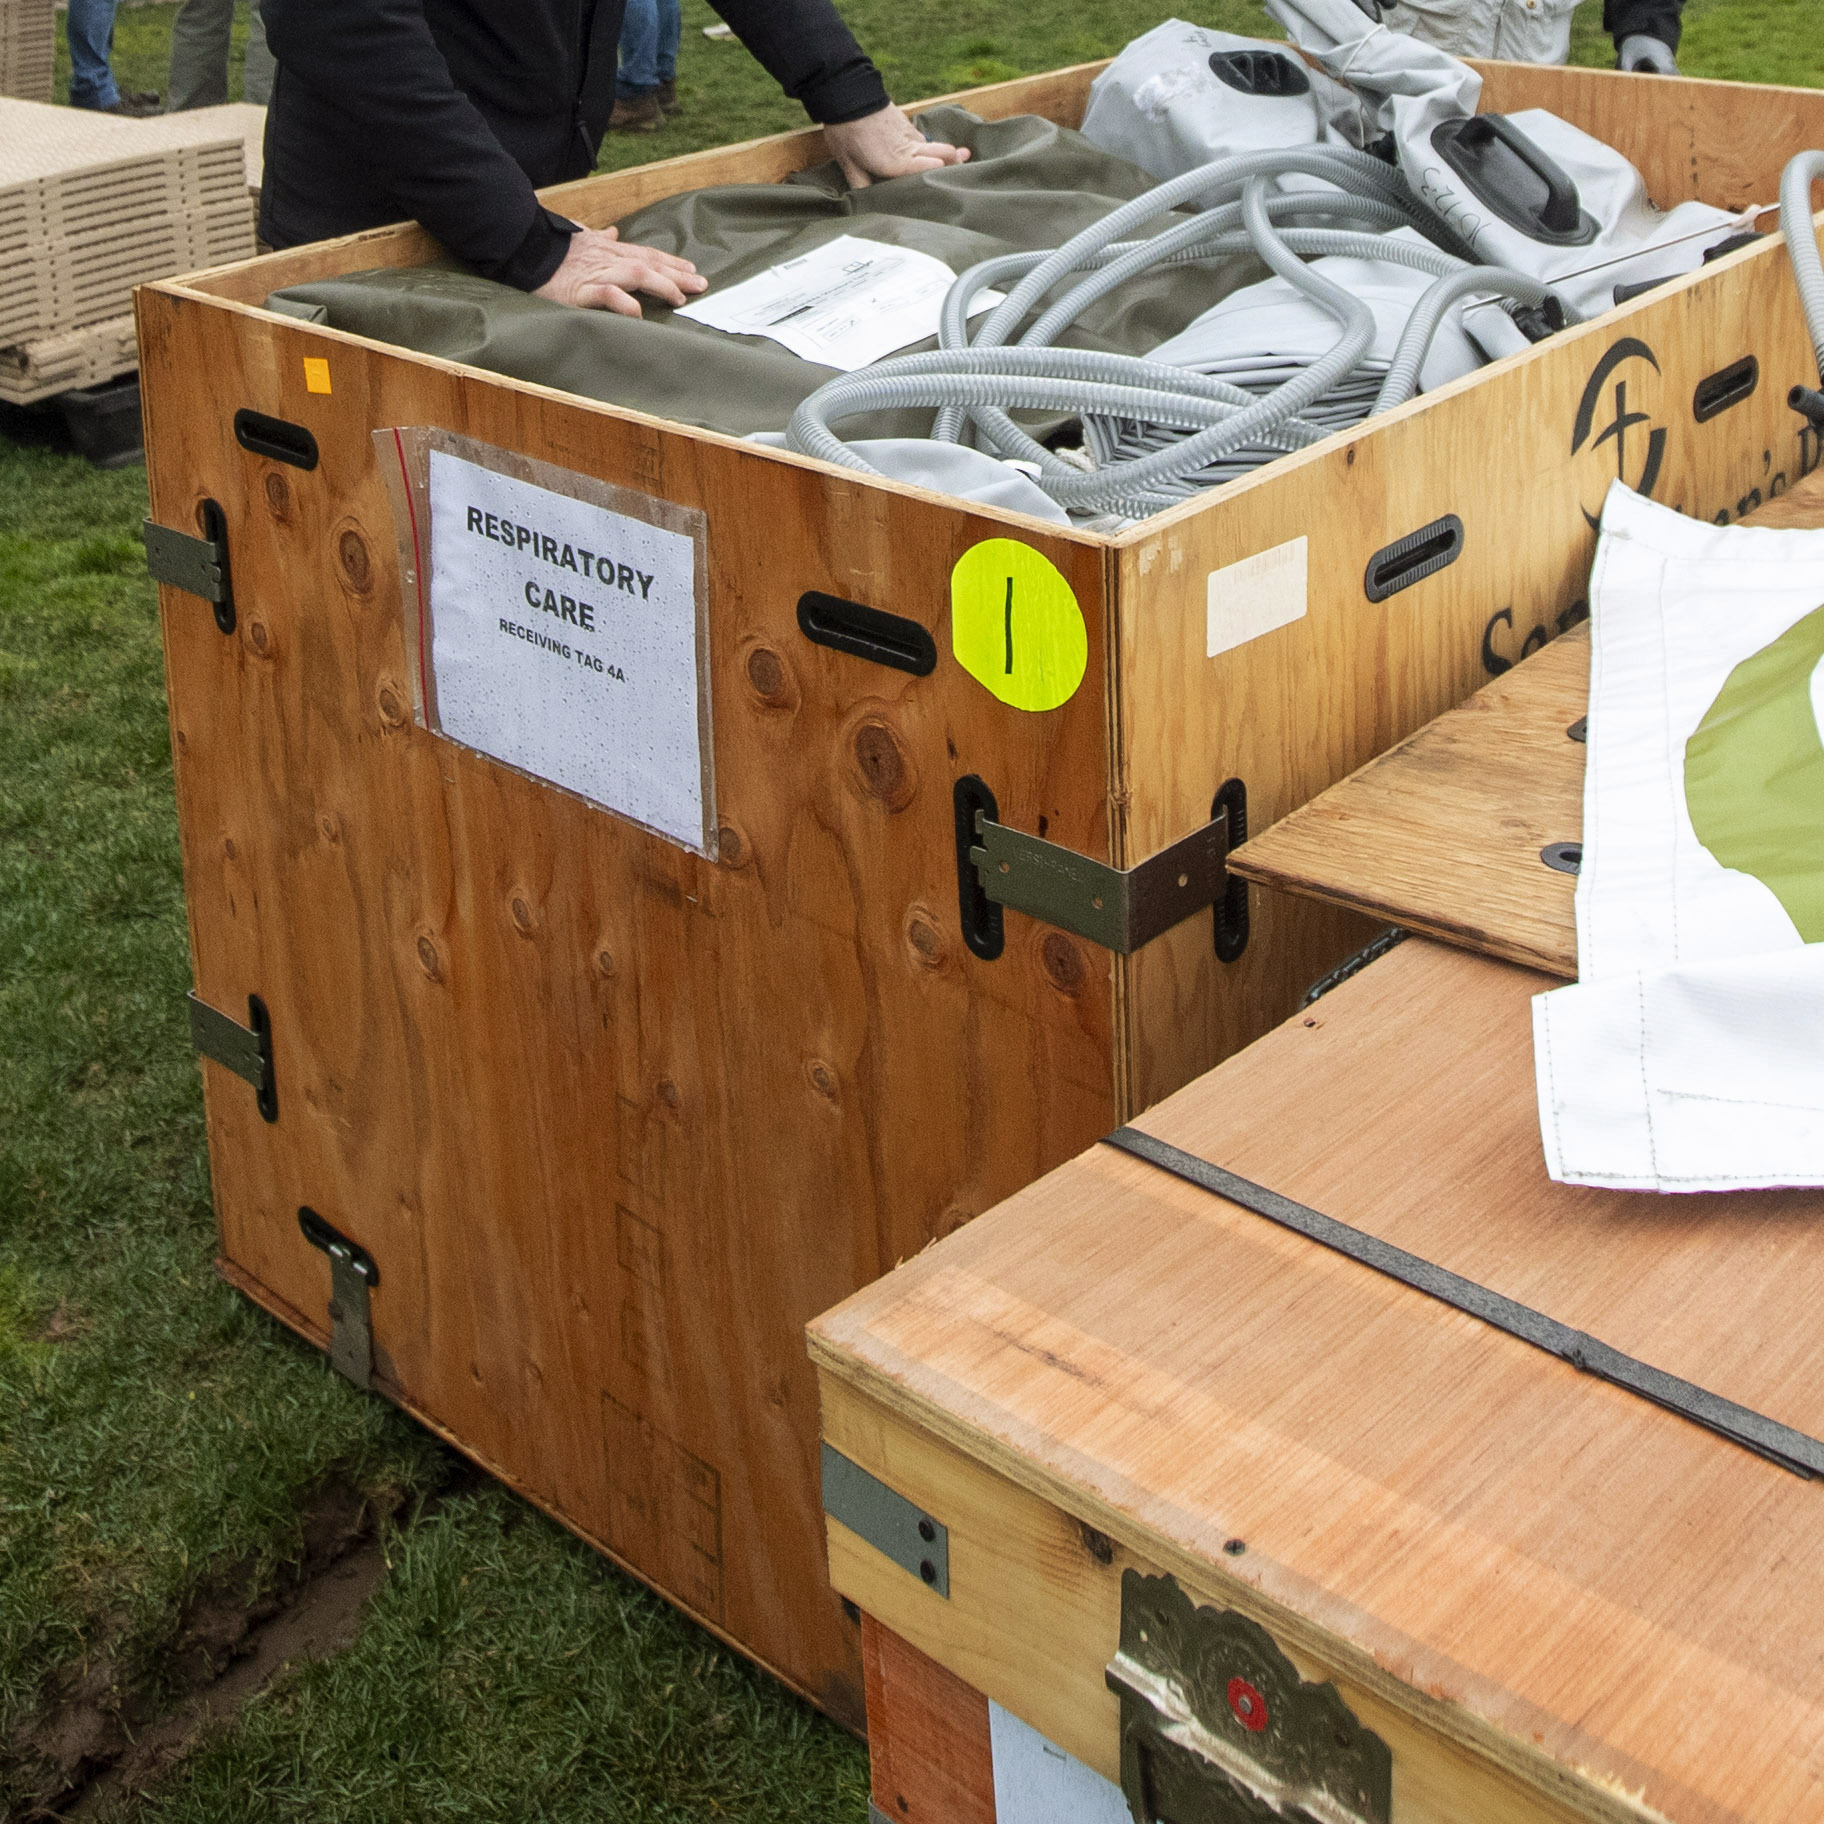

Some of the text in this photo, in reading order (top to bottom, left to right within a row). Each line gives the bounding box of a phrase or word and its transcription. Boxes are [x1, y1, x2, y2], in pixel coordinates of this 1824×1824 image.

[467, 505, 655, 601] RESPIRATORY
[525, 580, 595, 629] CARE
[499, 617, 626, 684] RECEIVING TAG 4A
